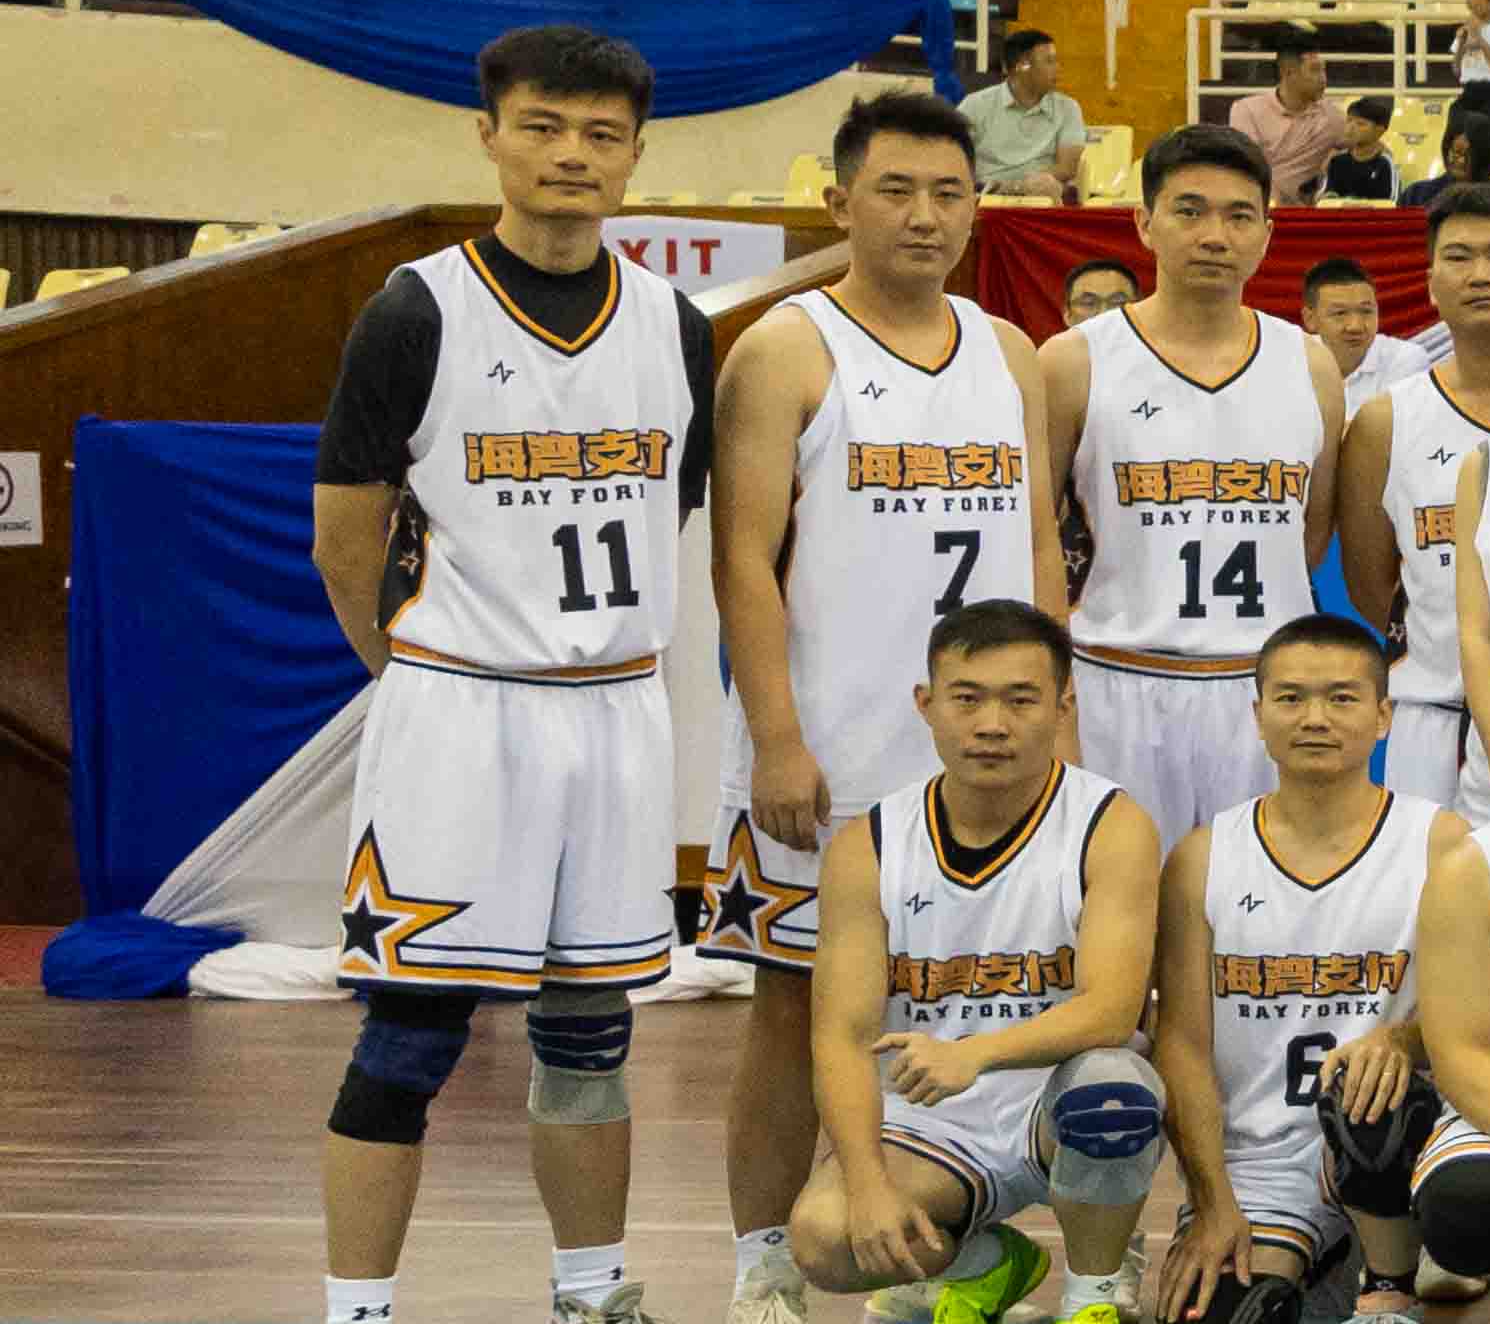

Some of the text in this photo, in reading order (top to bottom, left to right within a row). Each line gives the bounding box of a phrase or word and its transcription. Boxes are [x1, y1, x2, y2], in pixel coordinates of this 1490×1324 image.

[617, 238, 721, 276] XIT
[497, 488, 552, 507] BAY
[873, 497, 926, 514] BAY
[1141, 509, 1291, 527] BAY FOREX
[552, 520, 640, 613] 11
[933, 530, 981, 616] 7
[1178, 539, 1264, 619] 14
[1238, 1001, 1381, 1018] BAY FOREX
